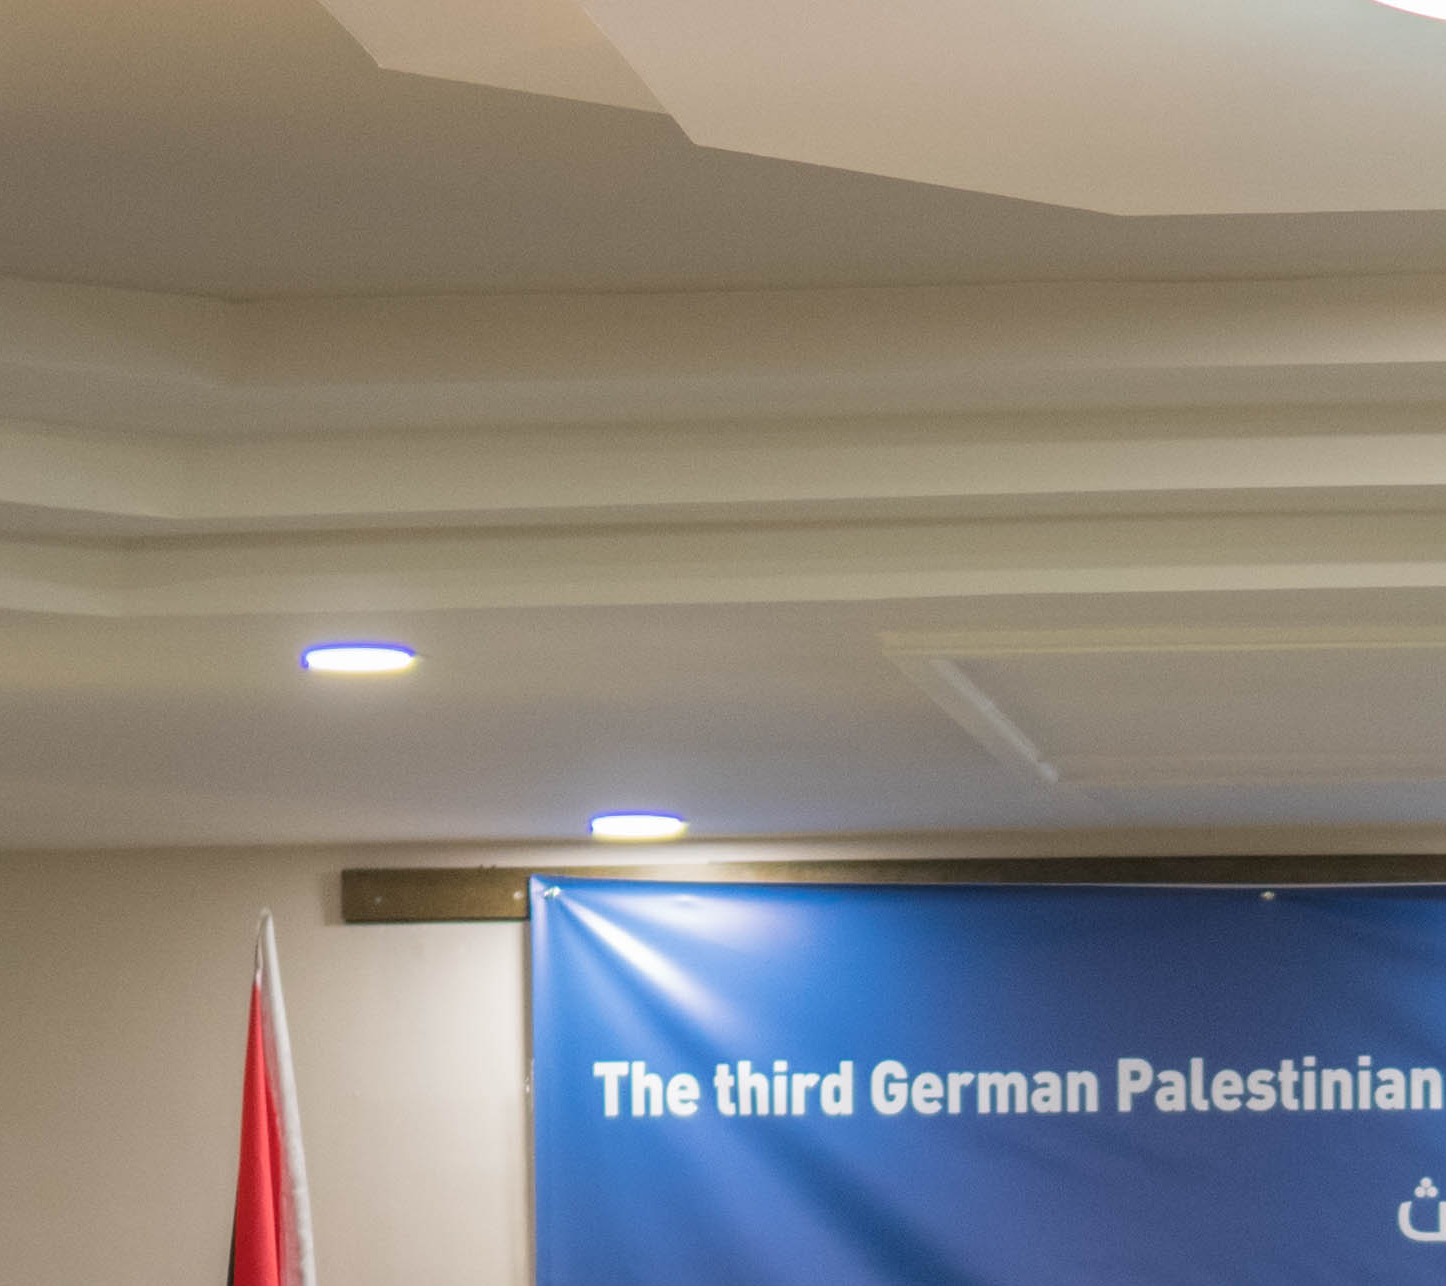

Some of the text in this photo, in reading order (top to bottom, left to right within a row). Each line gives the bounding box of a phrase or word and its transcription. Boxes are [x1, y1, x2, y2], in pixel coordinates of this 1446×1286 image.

[592, 1060, 701, 1117] The
[714, 1059, 854, 1115] third
[871, 1060, 1097, 1115] German
[1119, 1056, 1443, 1111] Palestinian
